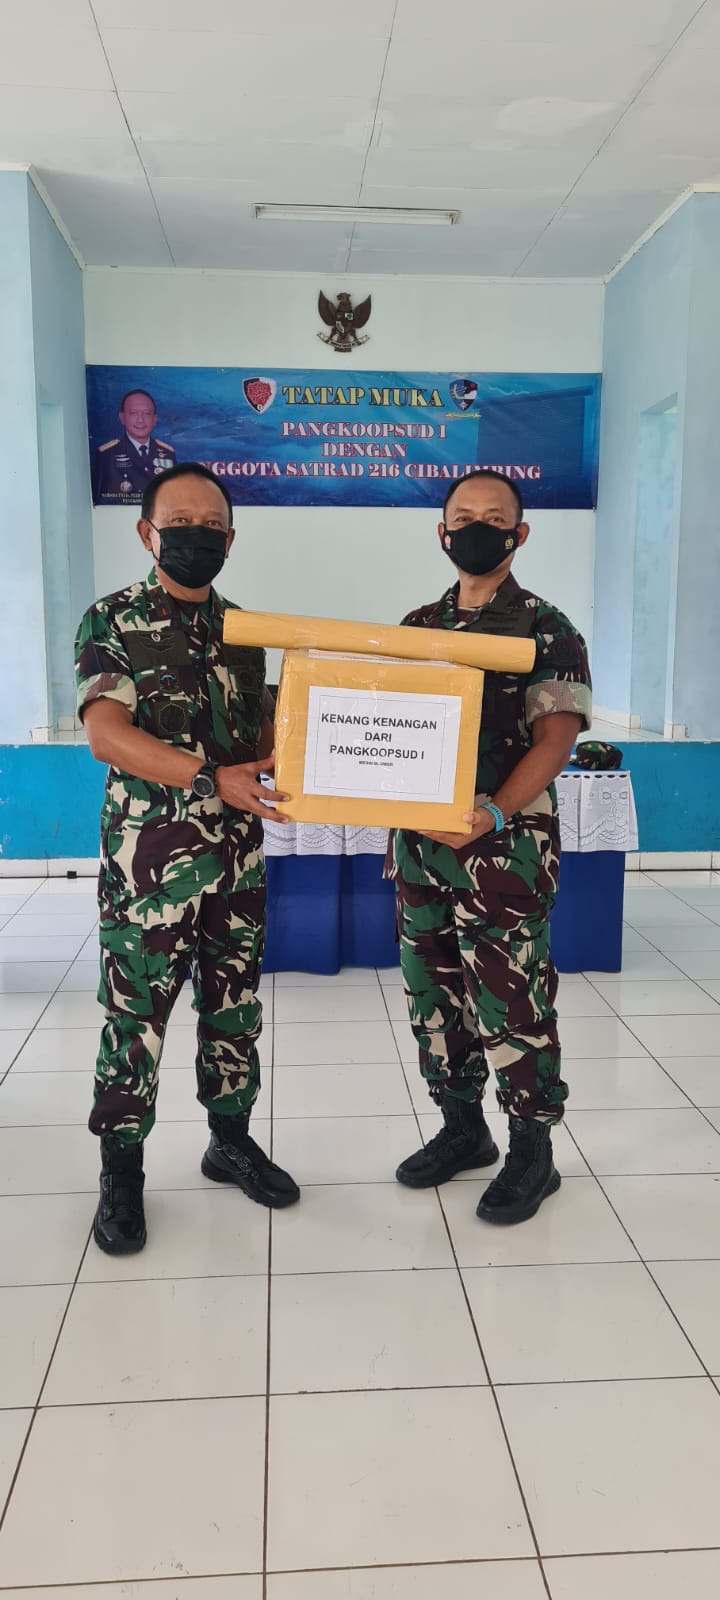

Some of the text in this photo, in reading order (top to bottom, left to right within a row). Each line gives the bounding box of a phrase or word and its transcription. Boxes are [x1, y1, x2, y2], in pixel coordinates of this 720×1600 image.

[281, 386, 444, 408] TATAP MUKA
[281, 421, 434, 439] PANGKOOPSUD
[321, 442, 408, 459] DENGAN
[285, 462, 364, 478] SATRAD
[368, 463, 400, 478] 216
[321, 713, 437, 730] KENANG KENANGAN
[364, 731, 392, 743] DARI
[329, 745, 418, 760] PANGKOOPSUD
